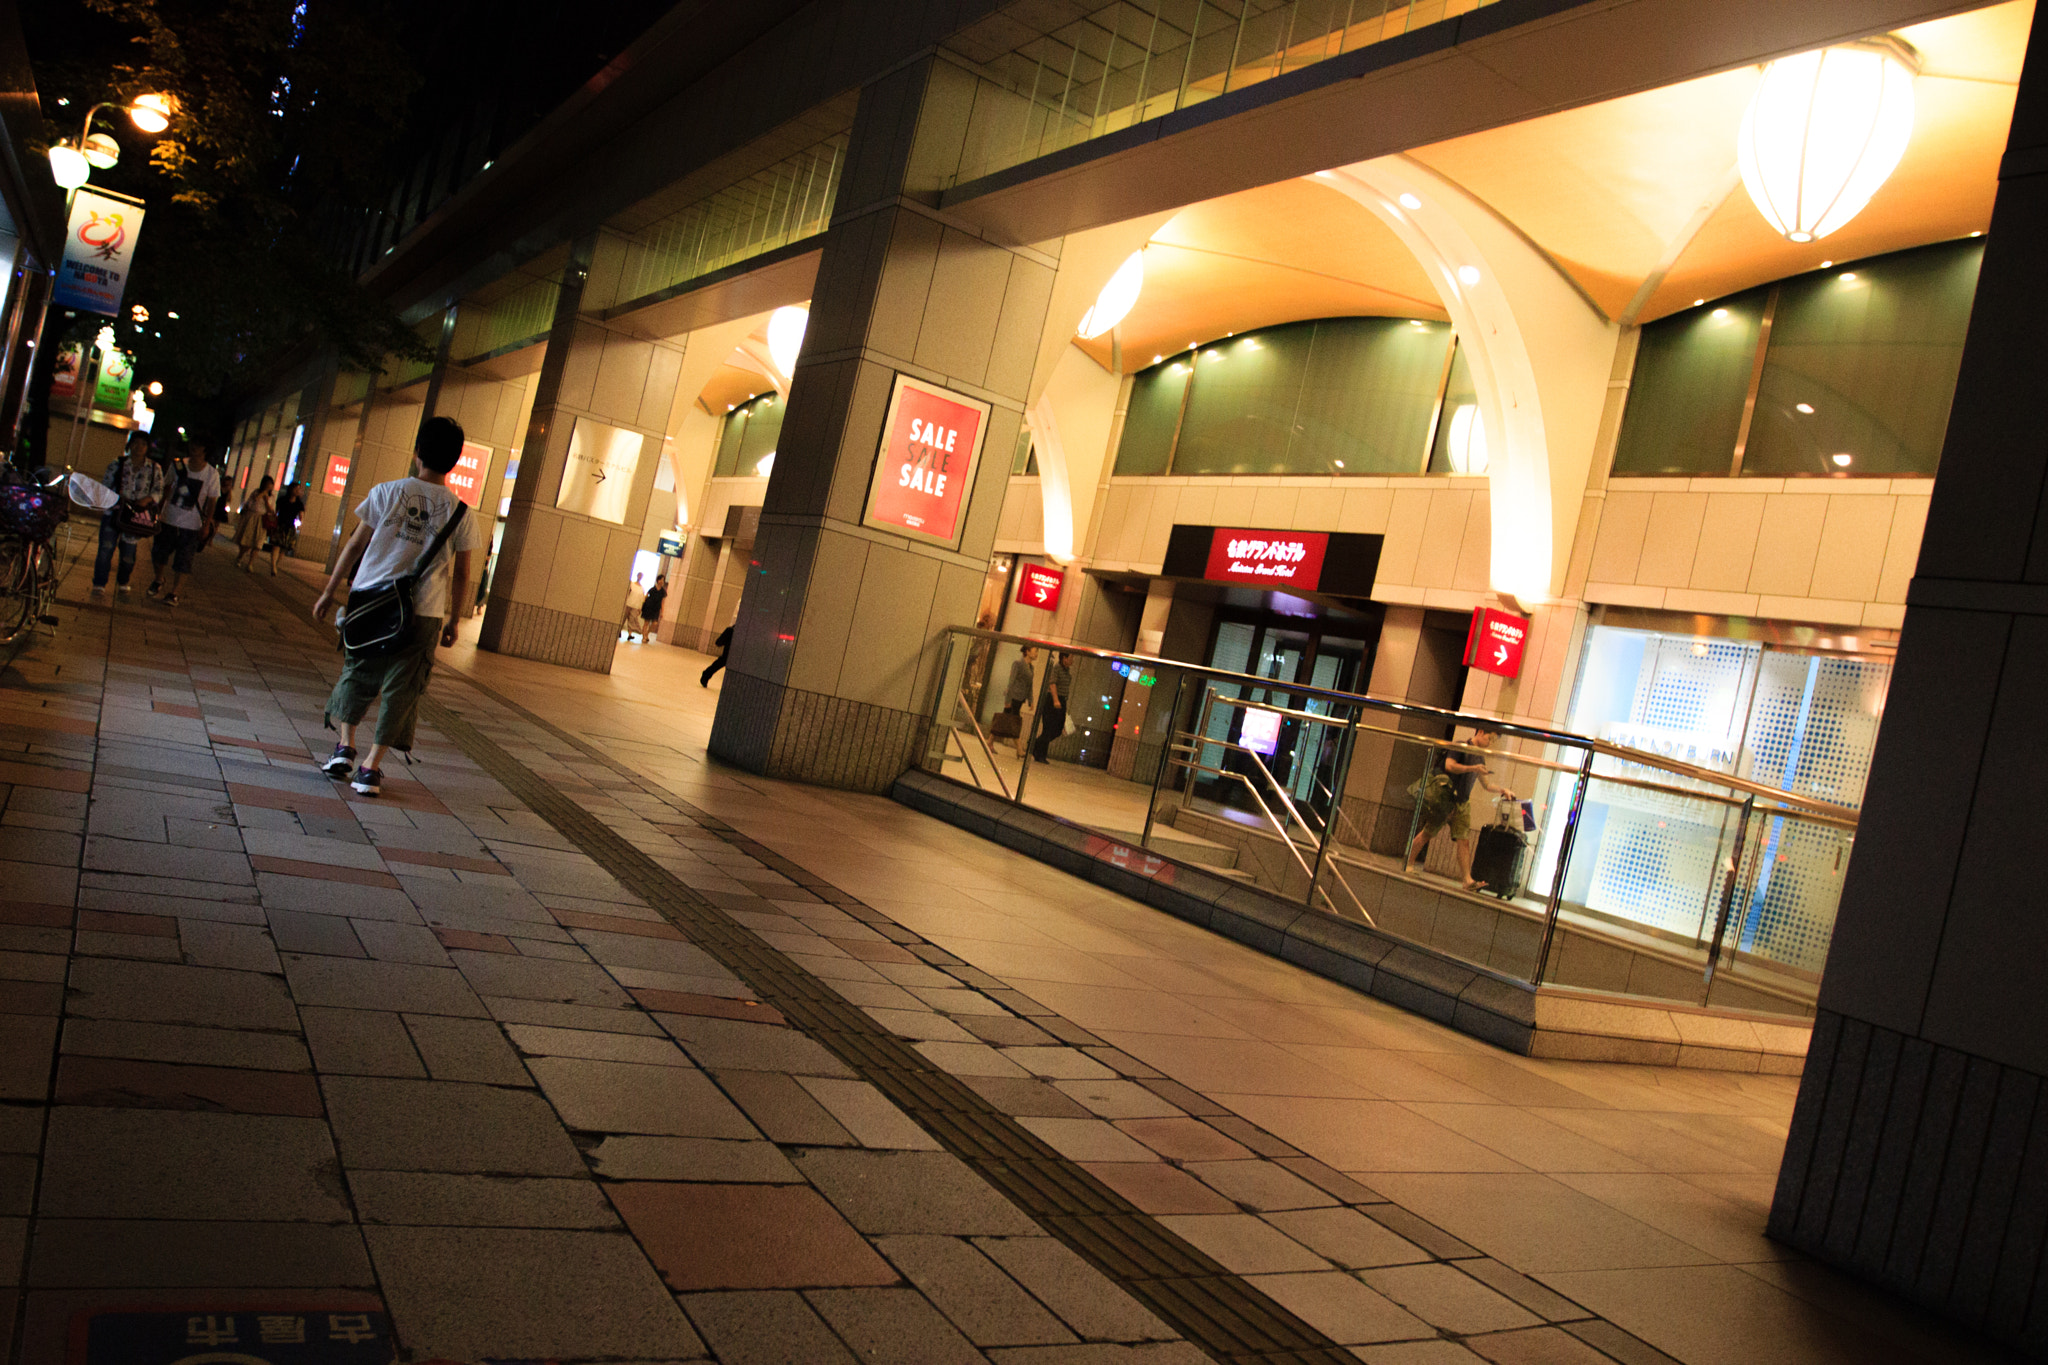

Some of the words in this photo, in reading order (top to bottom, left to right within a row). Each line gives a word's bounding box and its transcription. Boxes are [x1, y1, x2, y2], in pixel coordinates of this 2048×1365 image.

[66, 260, 107, 277] WELCOME
[109, 271, 120, 281] TO
[74, 271, 108, 286] NAGOYA
[909, 418, 958, 452] SALE
[906, 443, 951, 473] SALE
[450, 473, 474, 488] SALE
[899, 463, 947, 497] SALE
[1254, 563, 1278, 576] Grand
[1275, 564, 1296, 577] Hotel
